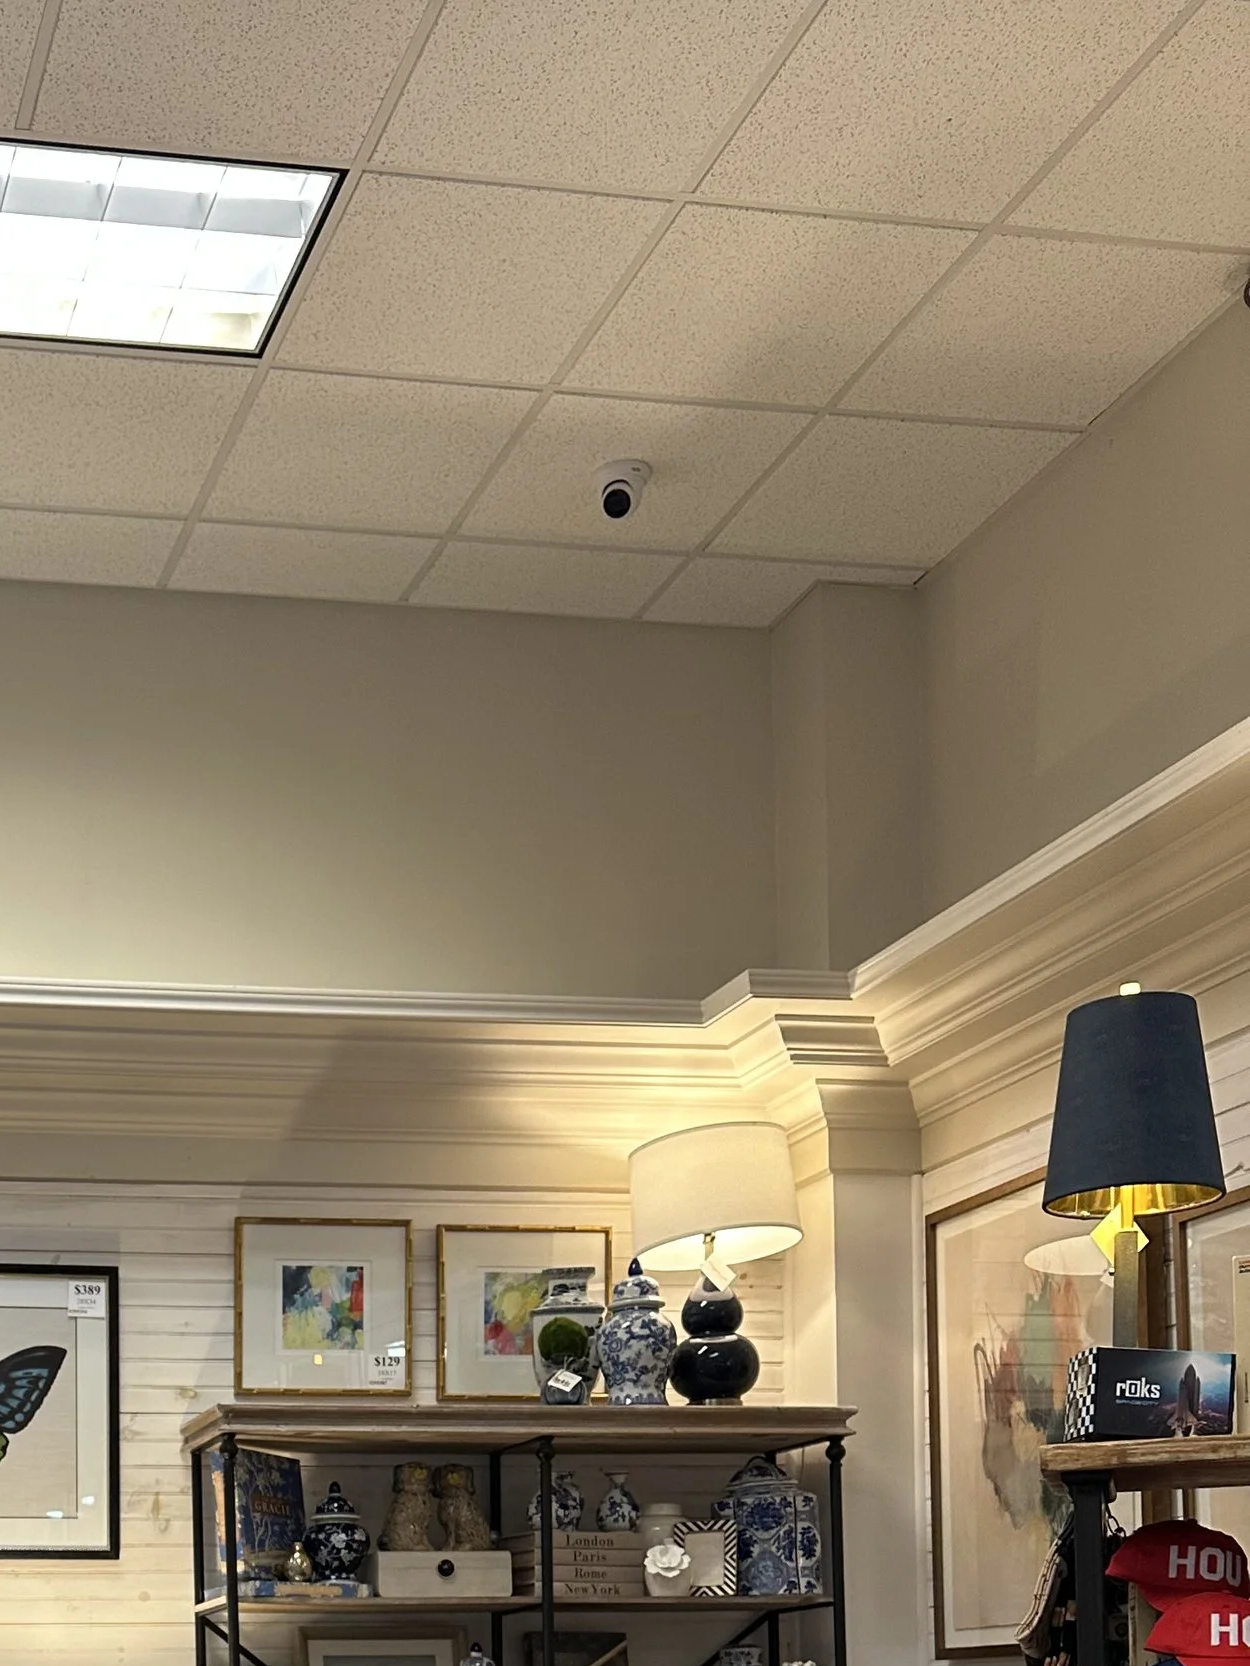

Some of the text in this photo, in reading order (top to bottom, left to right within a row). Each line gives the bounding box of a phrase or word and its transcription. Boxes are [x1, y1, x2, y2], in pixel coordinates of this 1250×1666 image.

[73, 1284, 101, 1296] $389
[373, 1355, 401, 1367] $129
[566, 1533, 614, 1547] London
[573, 1550, 607, 1563] Paris
[1168, 1544, 1242, 1587] HOU
[574, 1567, 607, 1579] Rome
[564, 1583, 620, 1596] New York
